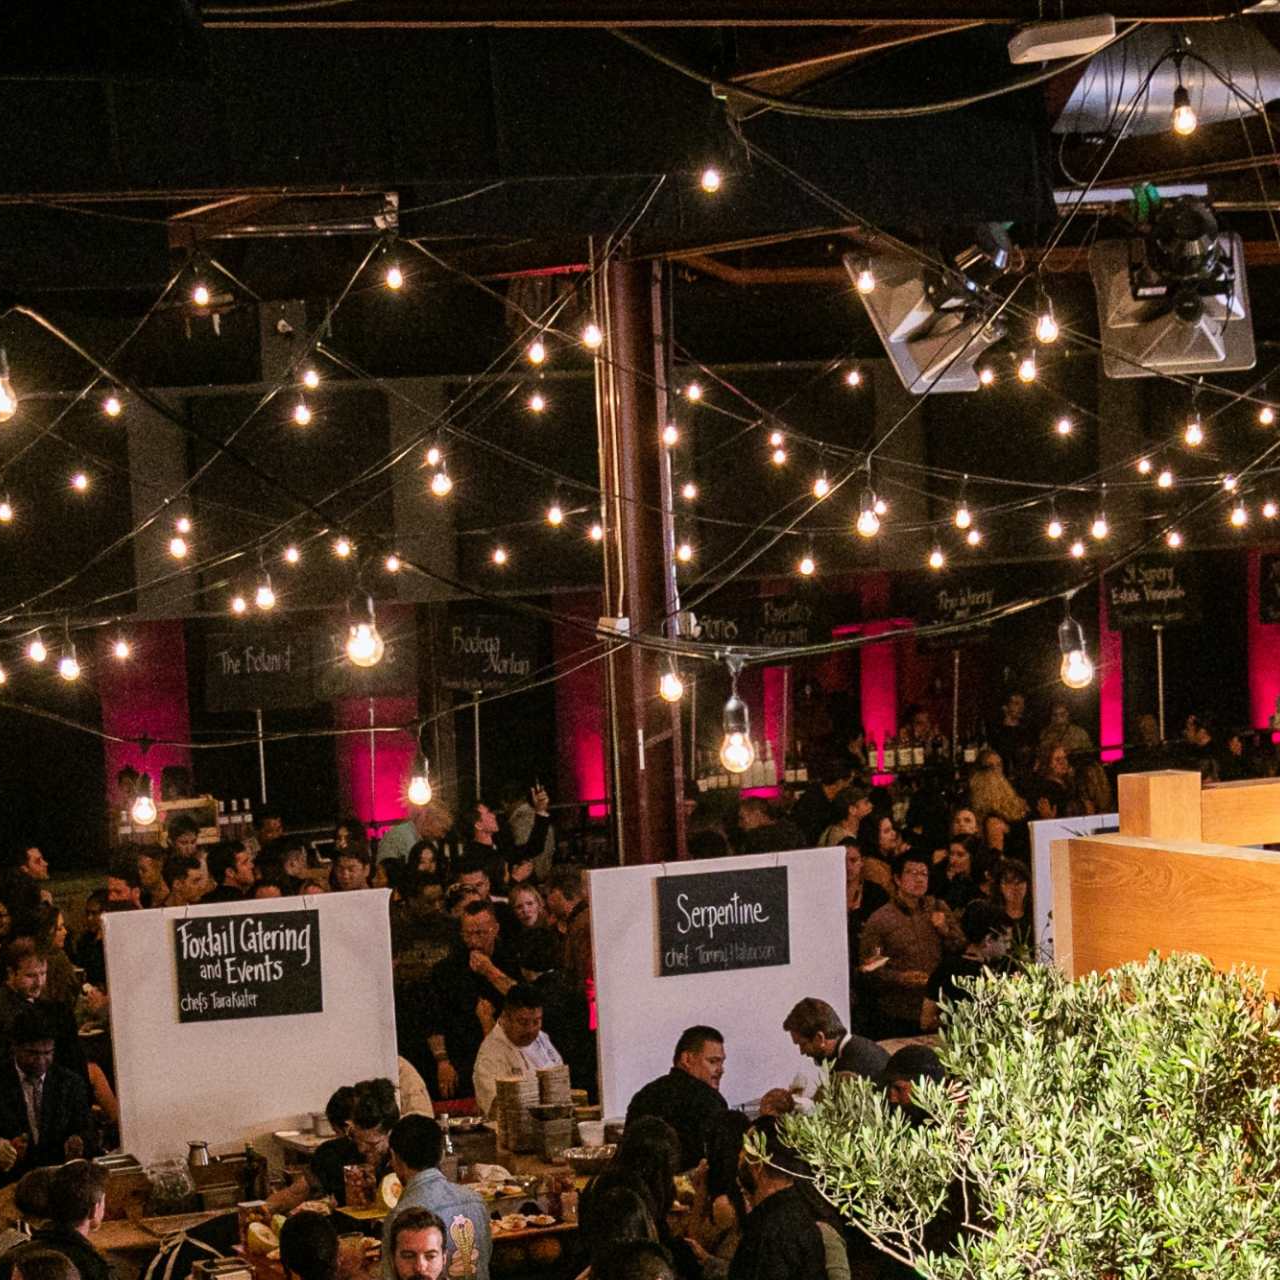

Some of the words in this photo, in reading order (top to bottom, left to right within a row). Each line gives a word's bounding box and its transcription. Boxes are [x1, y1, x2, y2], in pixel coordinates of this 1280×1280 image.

[676, 891, 770, 939] Serpentine
[176, 920, 236, 960] Foxtail
[240, 918, 311, 967] Catering
[664, 945, 689, 968] chef
[200, 959, 222, 979] and
[224, 954, 284, 985] Events
[180, 991, 208, 1013] chefs
